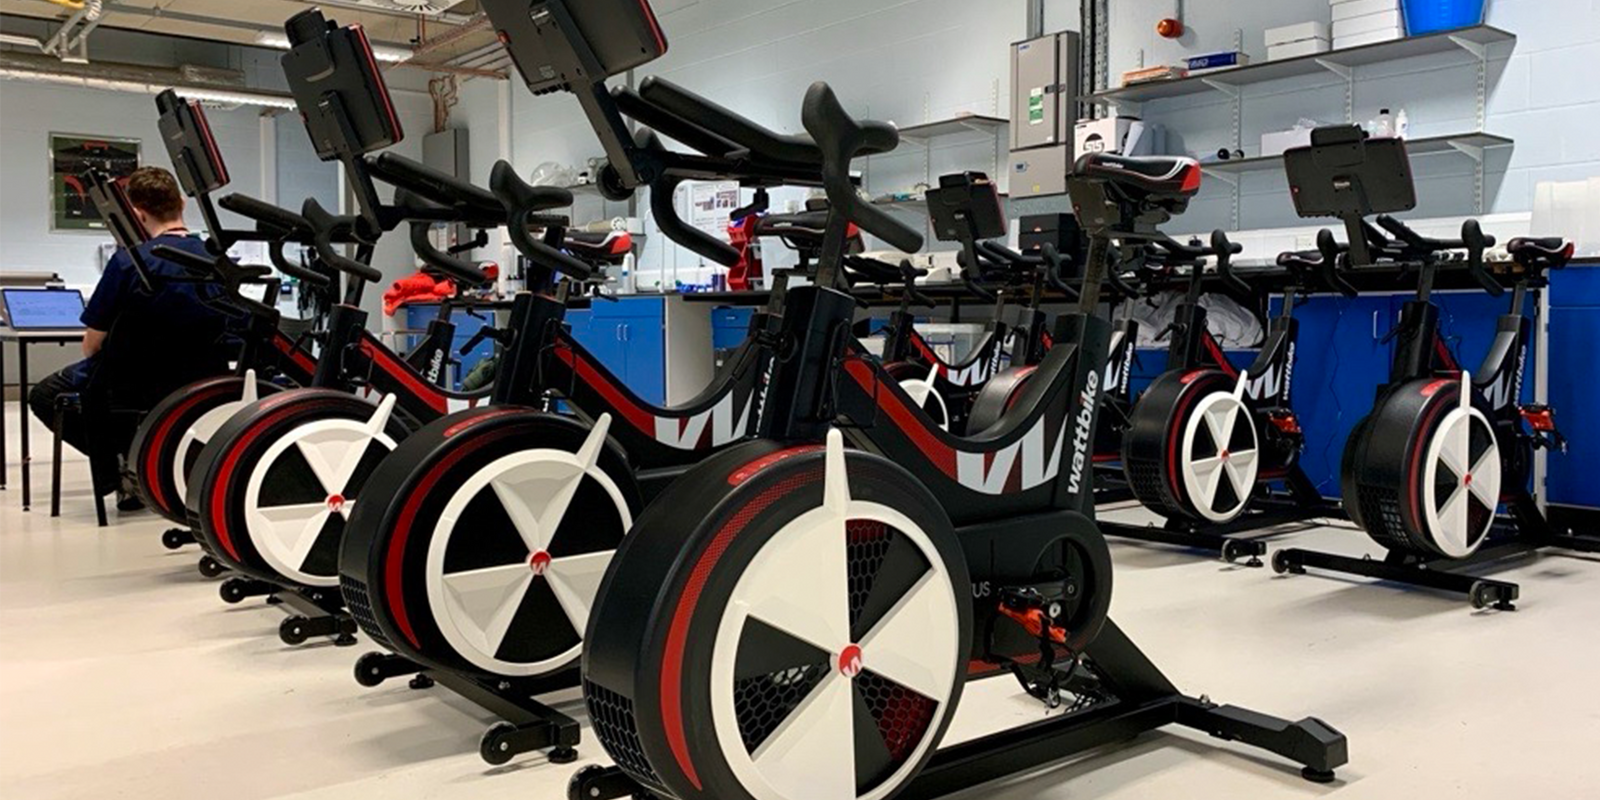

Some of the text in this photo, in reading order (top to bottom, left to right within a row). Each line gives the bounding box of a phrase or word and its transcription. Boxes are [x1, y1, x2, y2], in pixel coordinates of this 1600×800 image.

[1282, 341, 1295, 400] wattbike
[1067, 370, 1099, 494] wattbike
[972, 581, 990, 598] US
